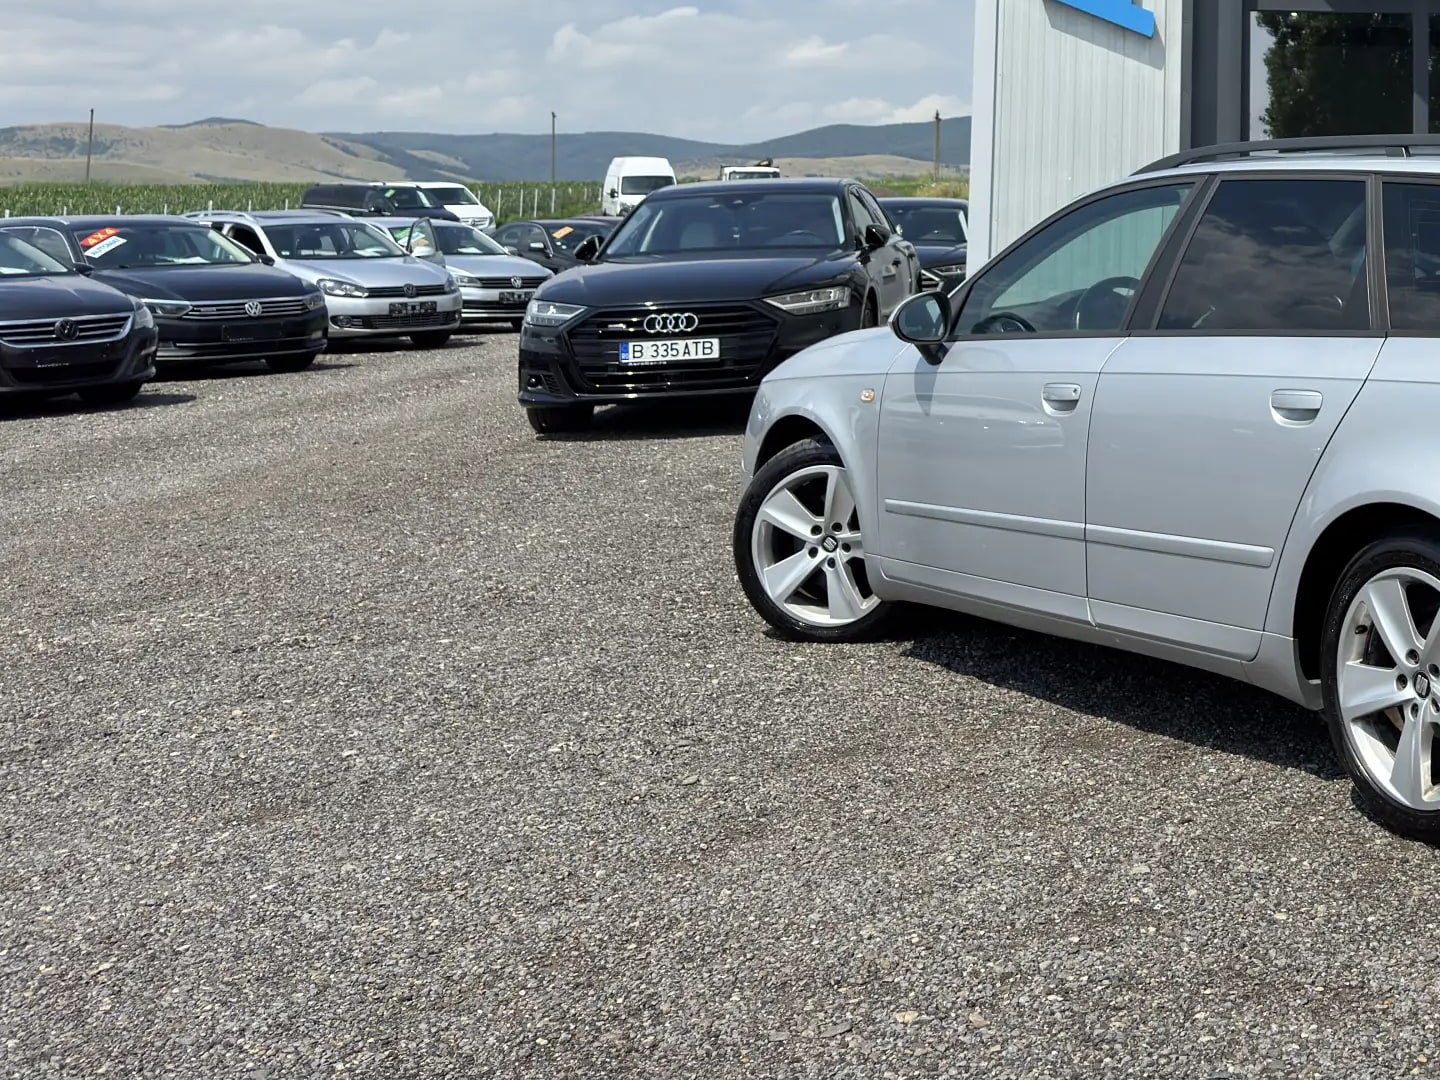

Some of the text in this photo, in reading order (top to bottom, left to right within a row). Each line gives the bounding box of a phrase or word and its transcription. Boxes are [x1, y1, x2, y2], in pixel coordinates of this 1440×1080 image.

[632, 340, 714, 359] B 335 ATB
